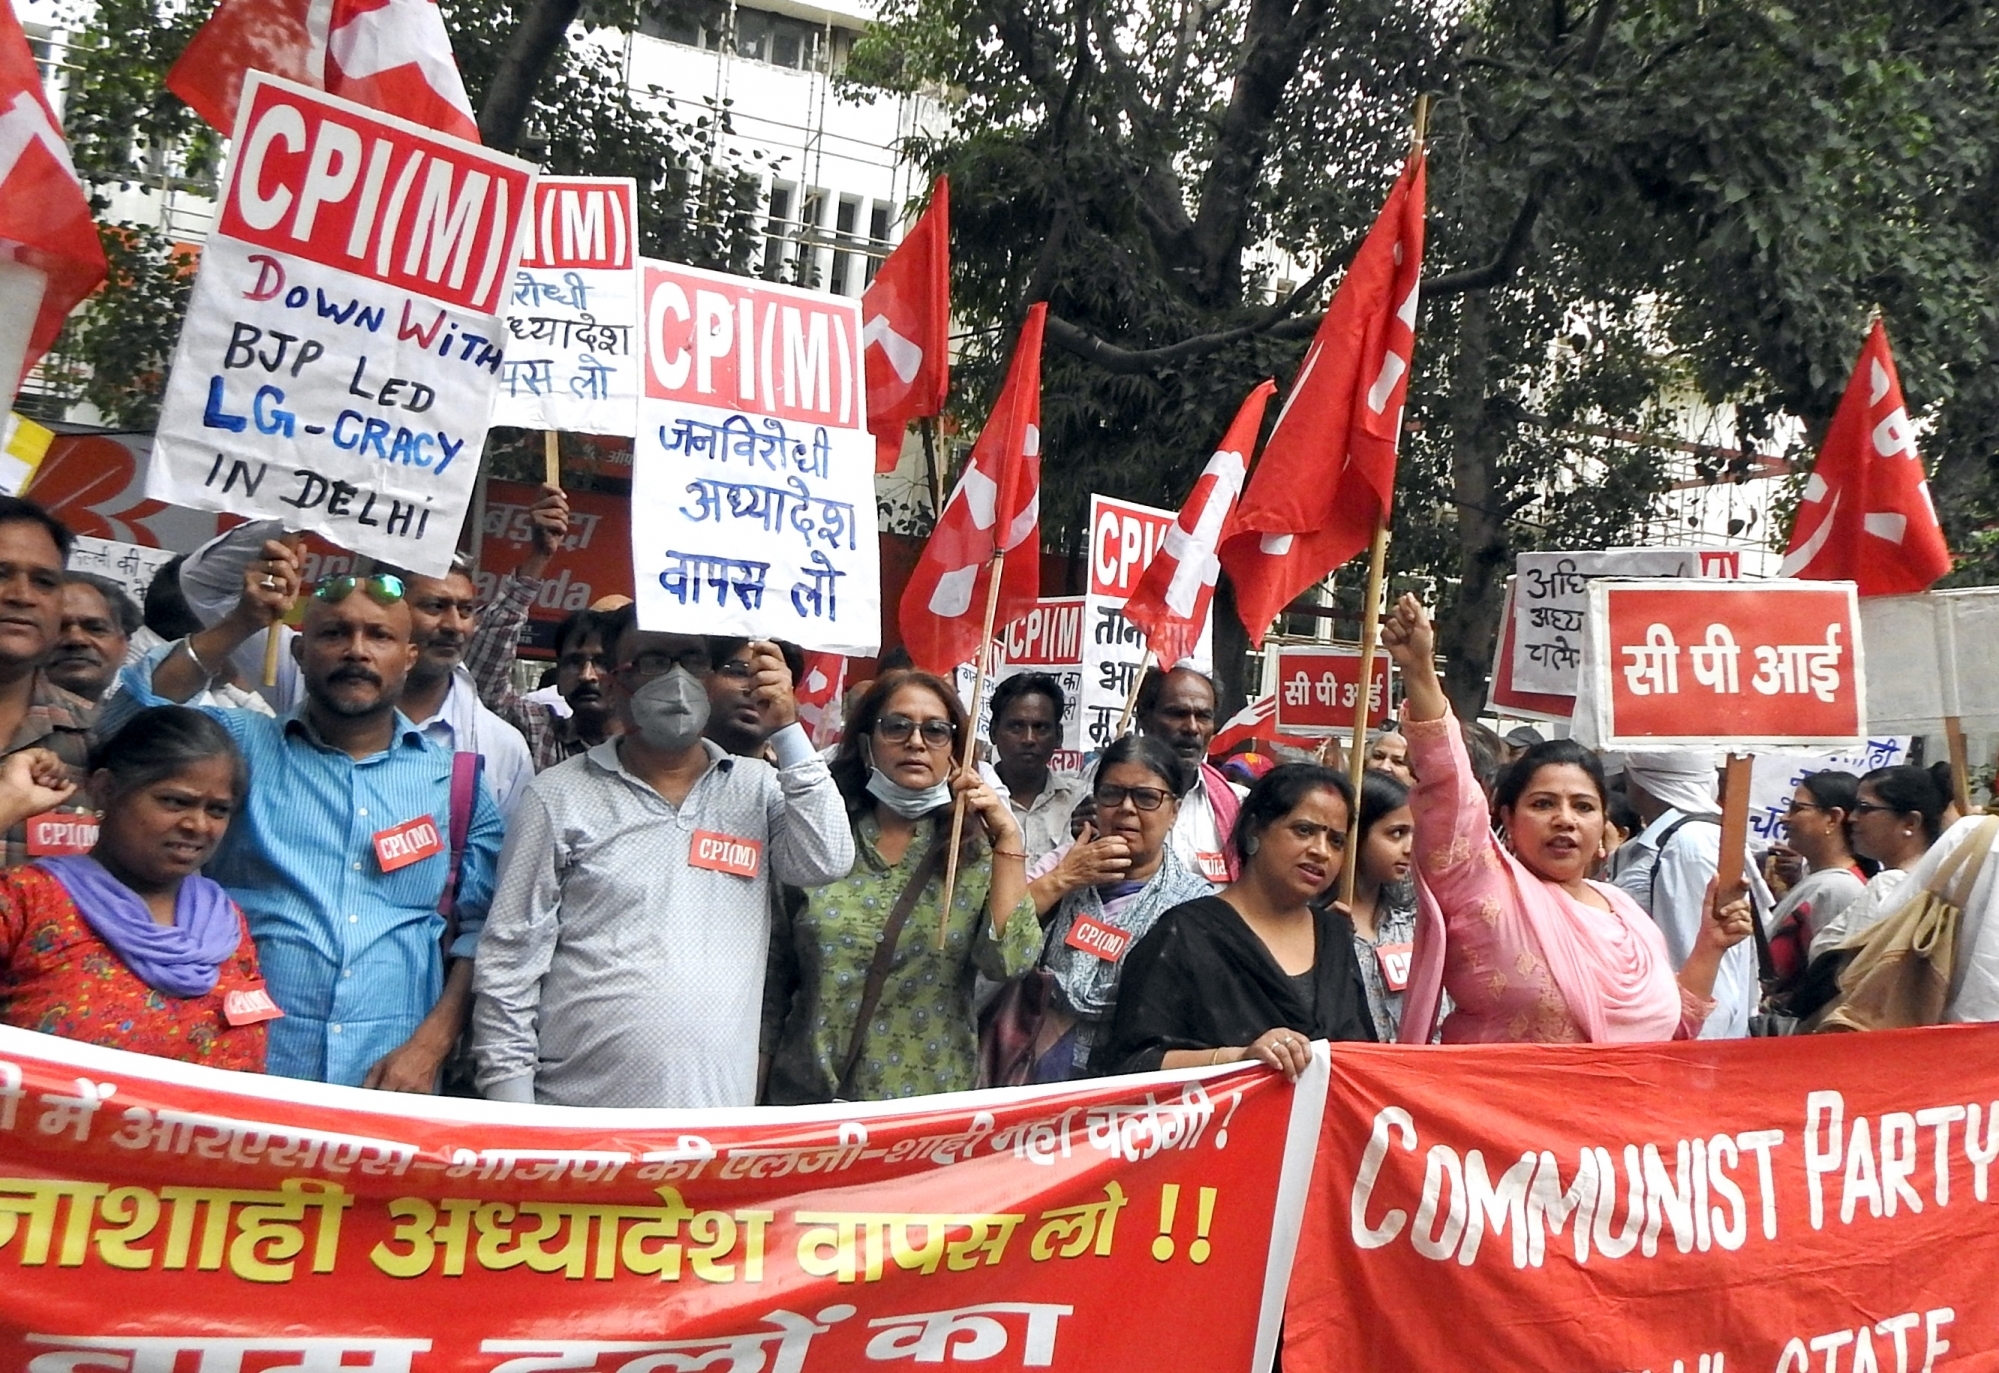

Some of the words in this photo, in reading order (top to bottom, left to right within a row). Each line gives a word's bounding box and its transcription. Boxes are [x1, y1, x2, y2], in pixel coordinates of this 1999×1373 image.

[239, 104, 508, 307] CPI(M)
[522, 188, 626, 266] I(M)
[242, 254, 385, 332] DOWN
[511, 271, 594, 311] रोधी
[224, 322, 325, 377] BJP
[350, 356, 436, 412] LED
[507, 312, 634, 355] ध्यादेश
[649, 281, 853, 424] CPI(M)
[501, 359, 554, 397] पस
[203, 374, 464, 475] LG-CRACY
[660, 415, 832, 479] जनविरोधी
[205, 453, 267, 497] IN
[679, 475, 856, 550] अध्यादेश
[660, 550, 771, 611] वापस
[791, 550, 847, 622] लो
[1009, 606, 1086, 663] CPI(M)
[1622, 623, 1680, 695] सी
[1690, 623, 1741, 694] पी
[1752, 623, 1842, 703] आई
[1284, 671, 1311, 706] सी
[1315, 671, 1338, 706] पी
[38, 822, 100, 850] CPI(M
[380, 823, 438, 860] CPI(M)
[699, 838, 757, 871] CPI(M)
[1077, 923, 1125, 957] CPI(M)
[38, 1077, 117, 1142] में
[637, 1135, 718, 1181] की
[1352, 1106, 1784, 1268] COMMUNIST
[1803, 1090, 1999, 1230] PARTY
[0, 1177, 354, 1282] नाशाही
[370, 1186, 774, 1284] अध्यादेश
[795, 1211, 1025, 1284] वापस
[1029, 1180, 1128, 1262] लो
[866, 1303, 1074, 1366] का
